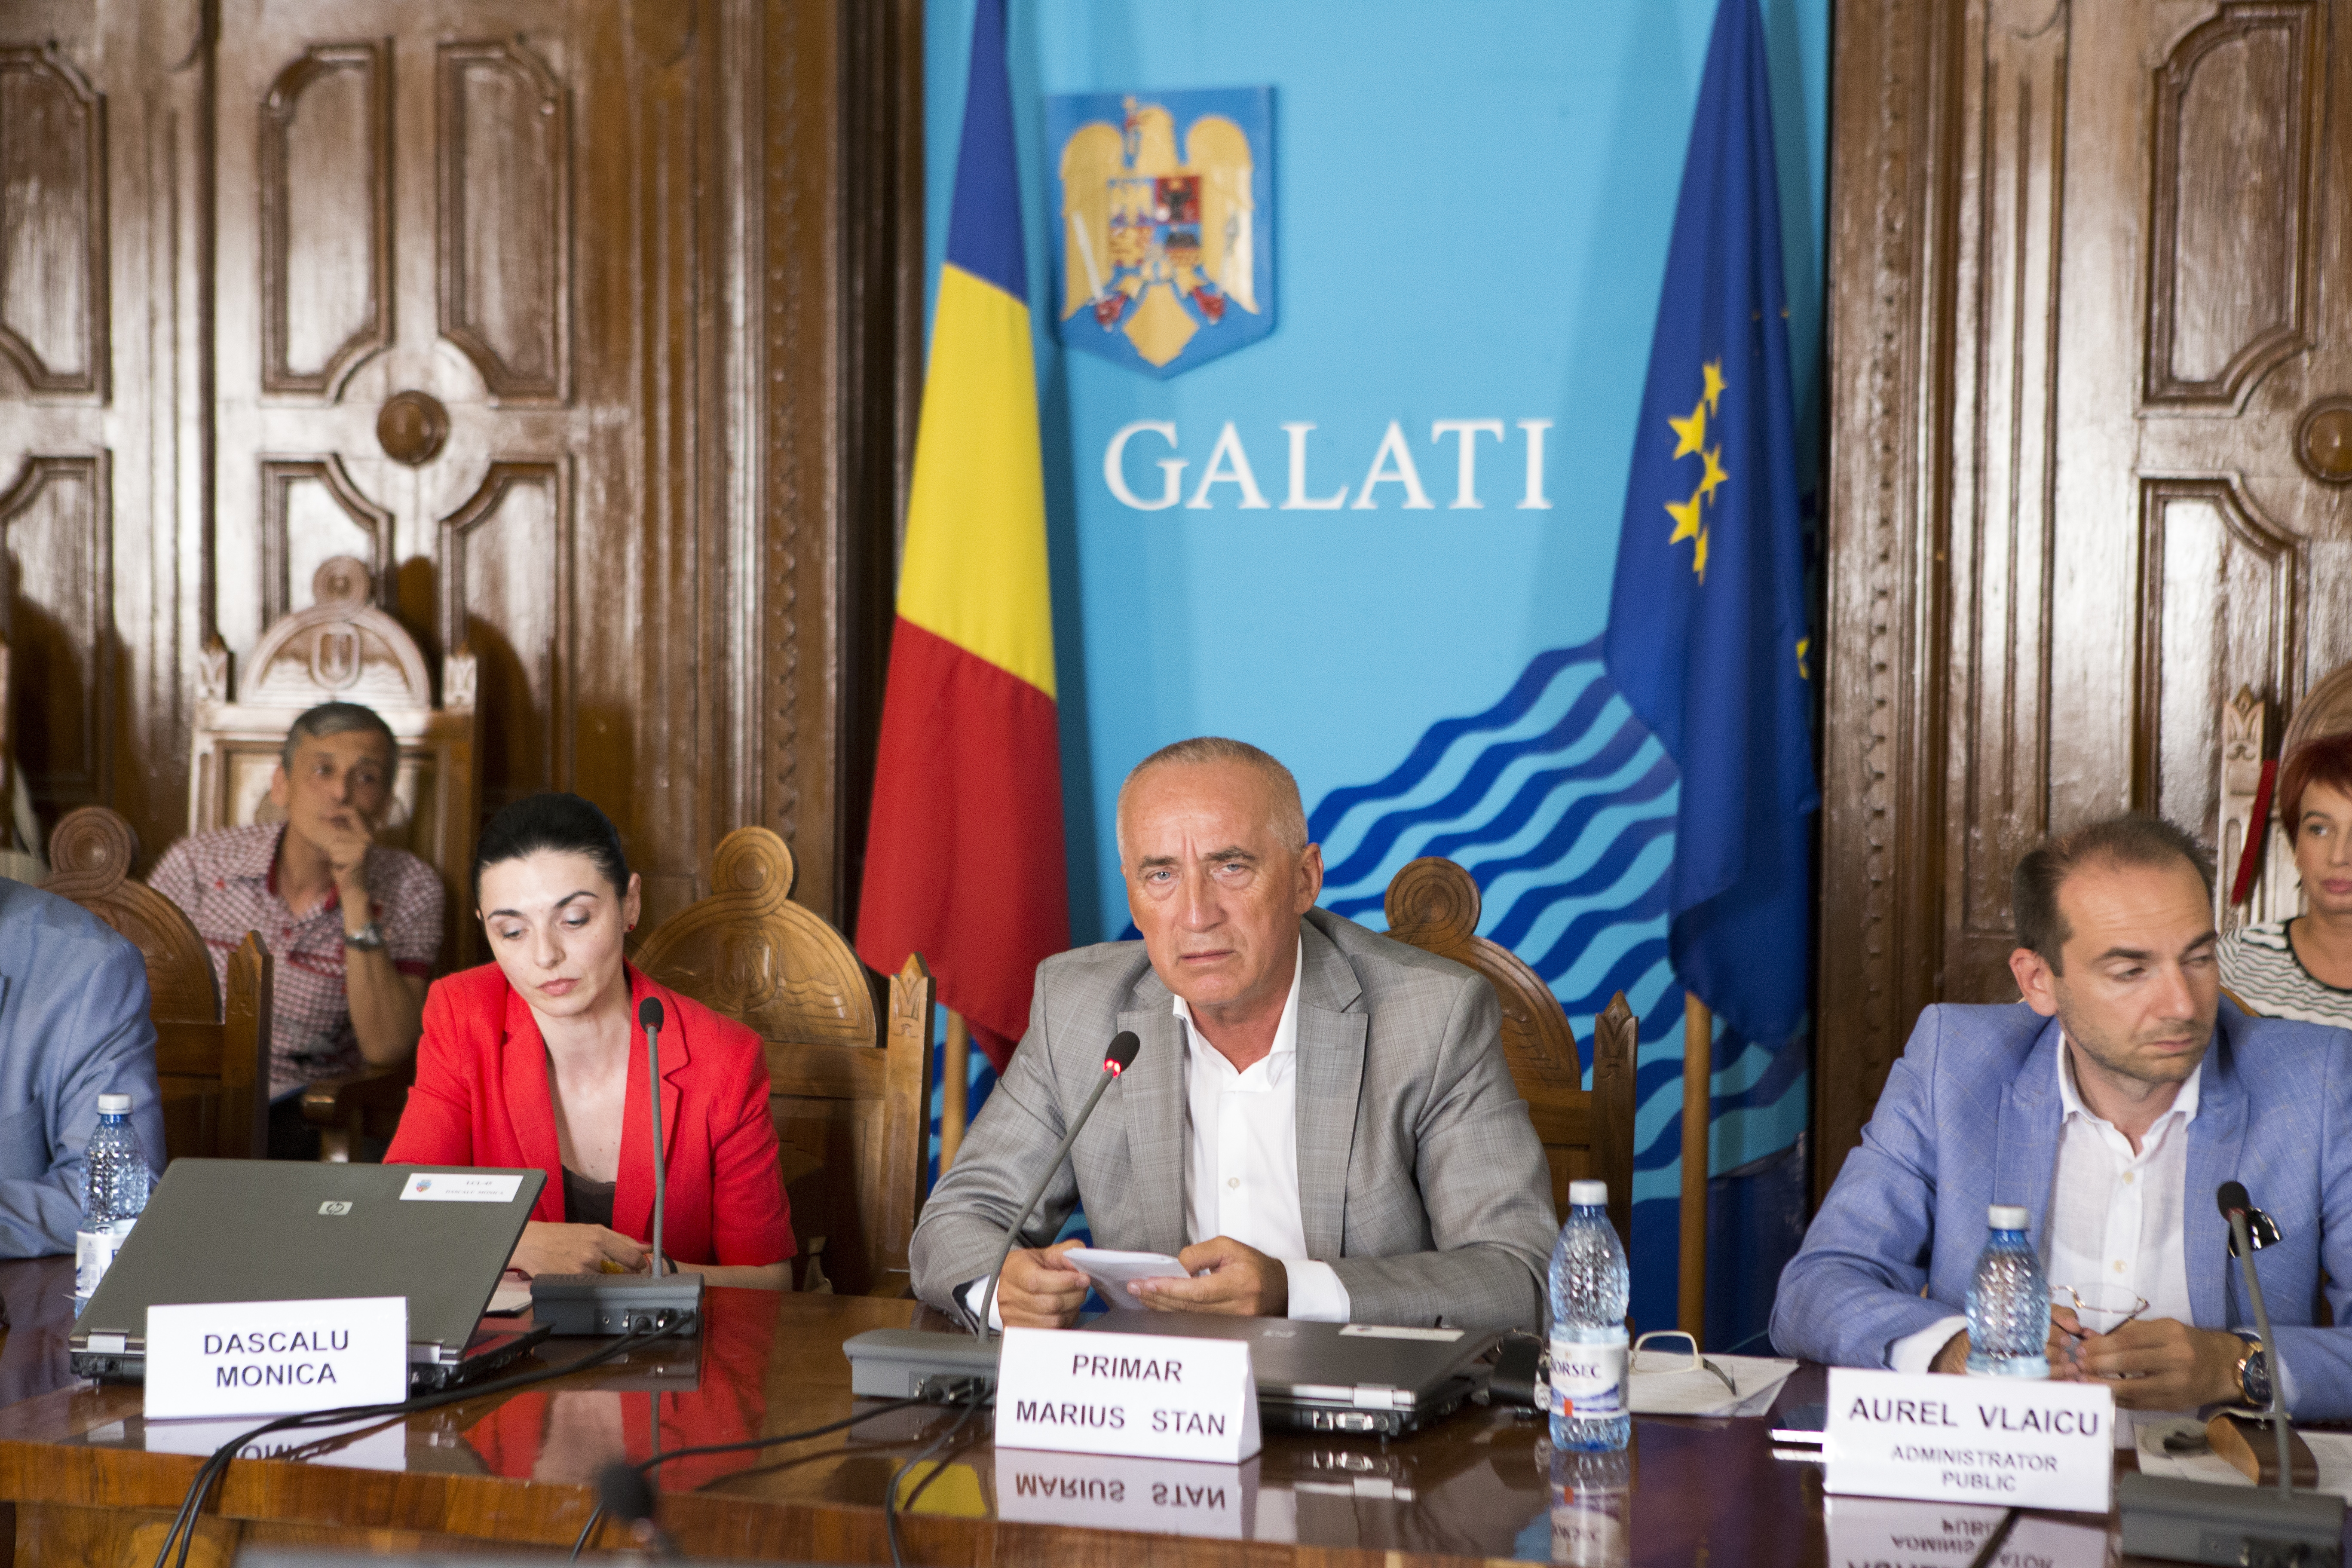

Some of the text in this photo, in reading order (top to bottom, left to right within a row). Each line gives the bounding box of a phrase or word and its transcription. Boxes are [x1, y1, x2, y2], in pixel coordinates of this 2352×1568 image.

[1104, 418, 1554, 511] GALATI
[204, 1330, 349, 1355] DASCALU
[216, 1363, 337, 1387] MONICA
[1072, 1354, 1183, 1382] PRIMAR
[1016, 1400, 1225, 1436] MARIUS STAN
[1849, 1397, 2098, 1436] AUREL VLAICU
[1893, 1446, 2057, 1472] ADMINISTRATOR
[1942, 1472, 2017, 1491] PUBLIC
